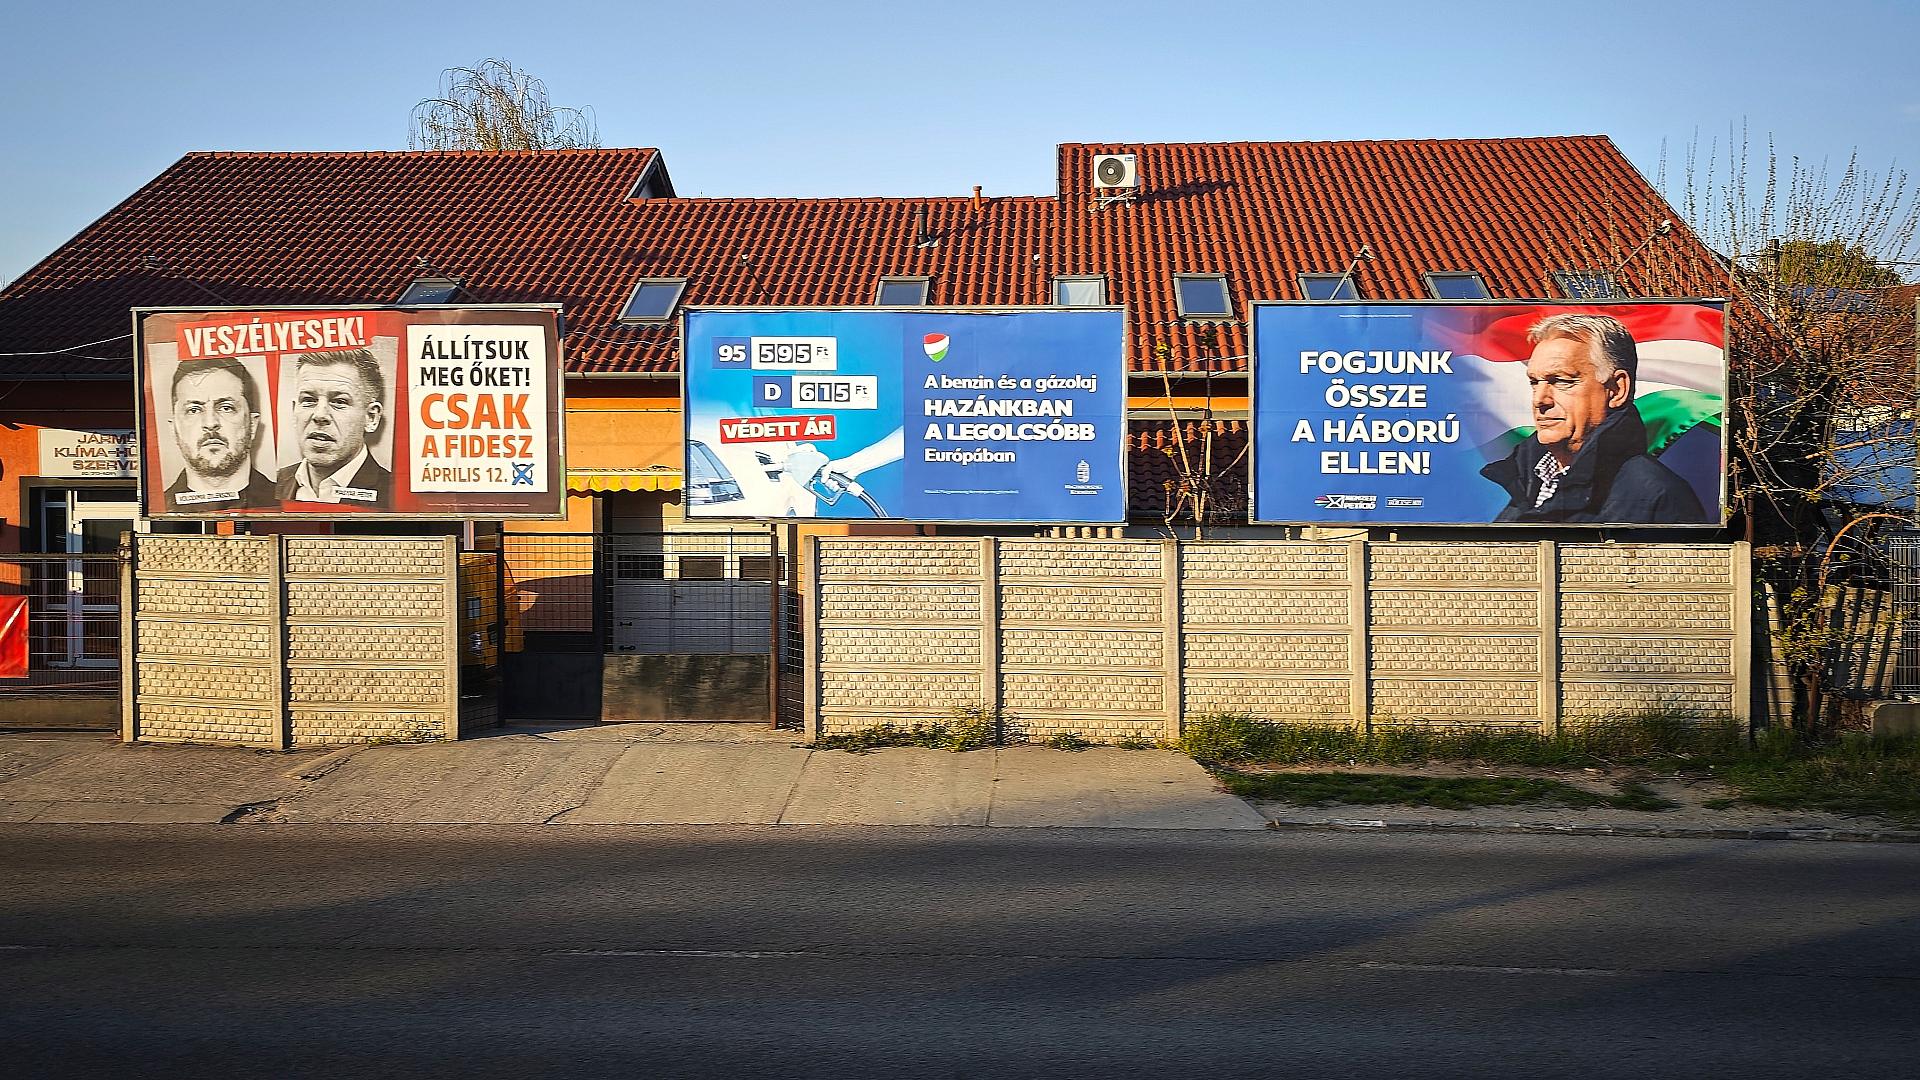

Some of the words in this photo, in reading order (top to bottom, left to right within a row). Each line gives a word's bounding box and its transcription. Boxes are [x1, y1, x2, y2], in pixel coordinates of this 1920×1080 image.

[184, 316, 365, 357] VESZÉLYESEK!
[421, 334, 529, 360] ÁLLÍTSUK
[718, 344, 747, 362] 95
[759, 343, 812, 364] 595
[817, 346, 829, 356] Ft
[1300, 351, 1453, 374] FOGJUNK
[420, 367, 464, 386] MEG
[470, 361, 530, 387] ŐKET!
[924, 375, 939, 389] A
[941, 374, 994, 390] benzin
[998, 374, 1016, 389] és
[1020, 379, 1032, 389] a
[1035, 374, 1097, 393] gázolaj
[764, 383, 782, 400] D
[799, 382, 850, 402] 615
[855, 385, 868, 395] Ft
[1325, 378, 1427, 408] ÖSSZE
[421, 393, 531, 429] CSAK
[924, 395, 1073, 417] HAZÁNKBAN
[722, 418, 800, 439] VÉDETT
[804, 417, 832, 436] ÁR
[924, 423, 943, 440] A
[947, 418, 1095, 441] LEGOLCSÓBB
[1291, 419, 1316, 443] A
[1323, 413, 1459, 443] HÁBORÚ
[421, 435, 439, 458] A
[445, 435, 533, 458] FIDESZ
[924, 447, 1015, 465] Európában
[421, 463, 481, 482] ÁPRILIS
[486, 467, 508, 482] 12.
[1321, 451, 1430, 474] ELLEN!
